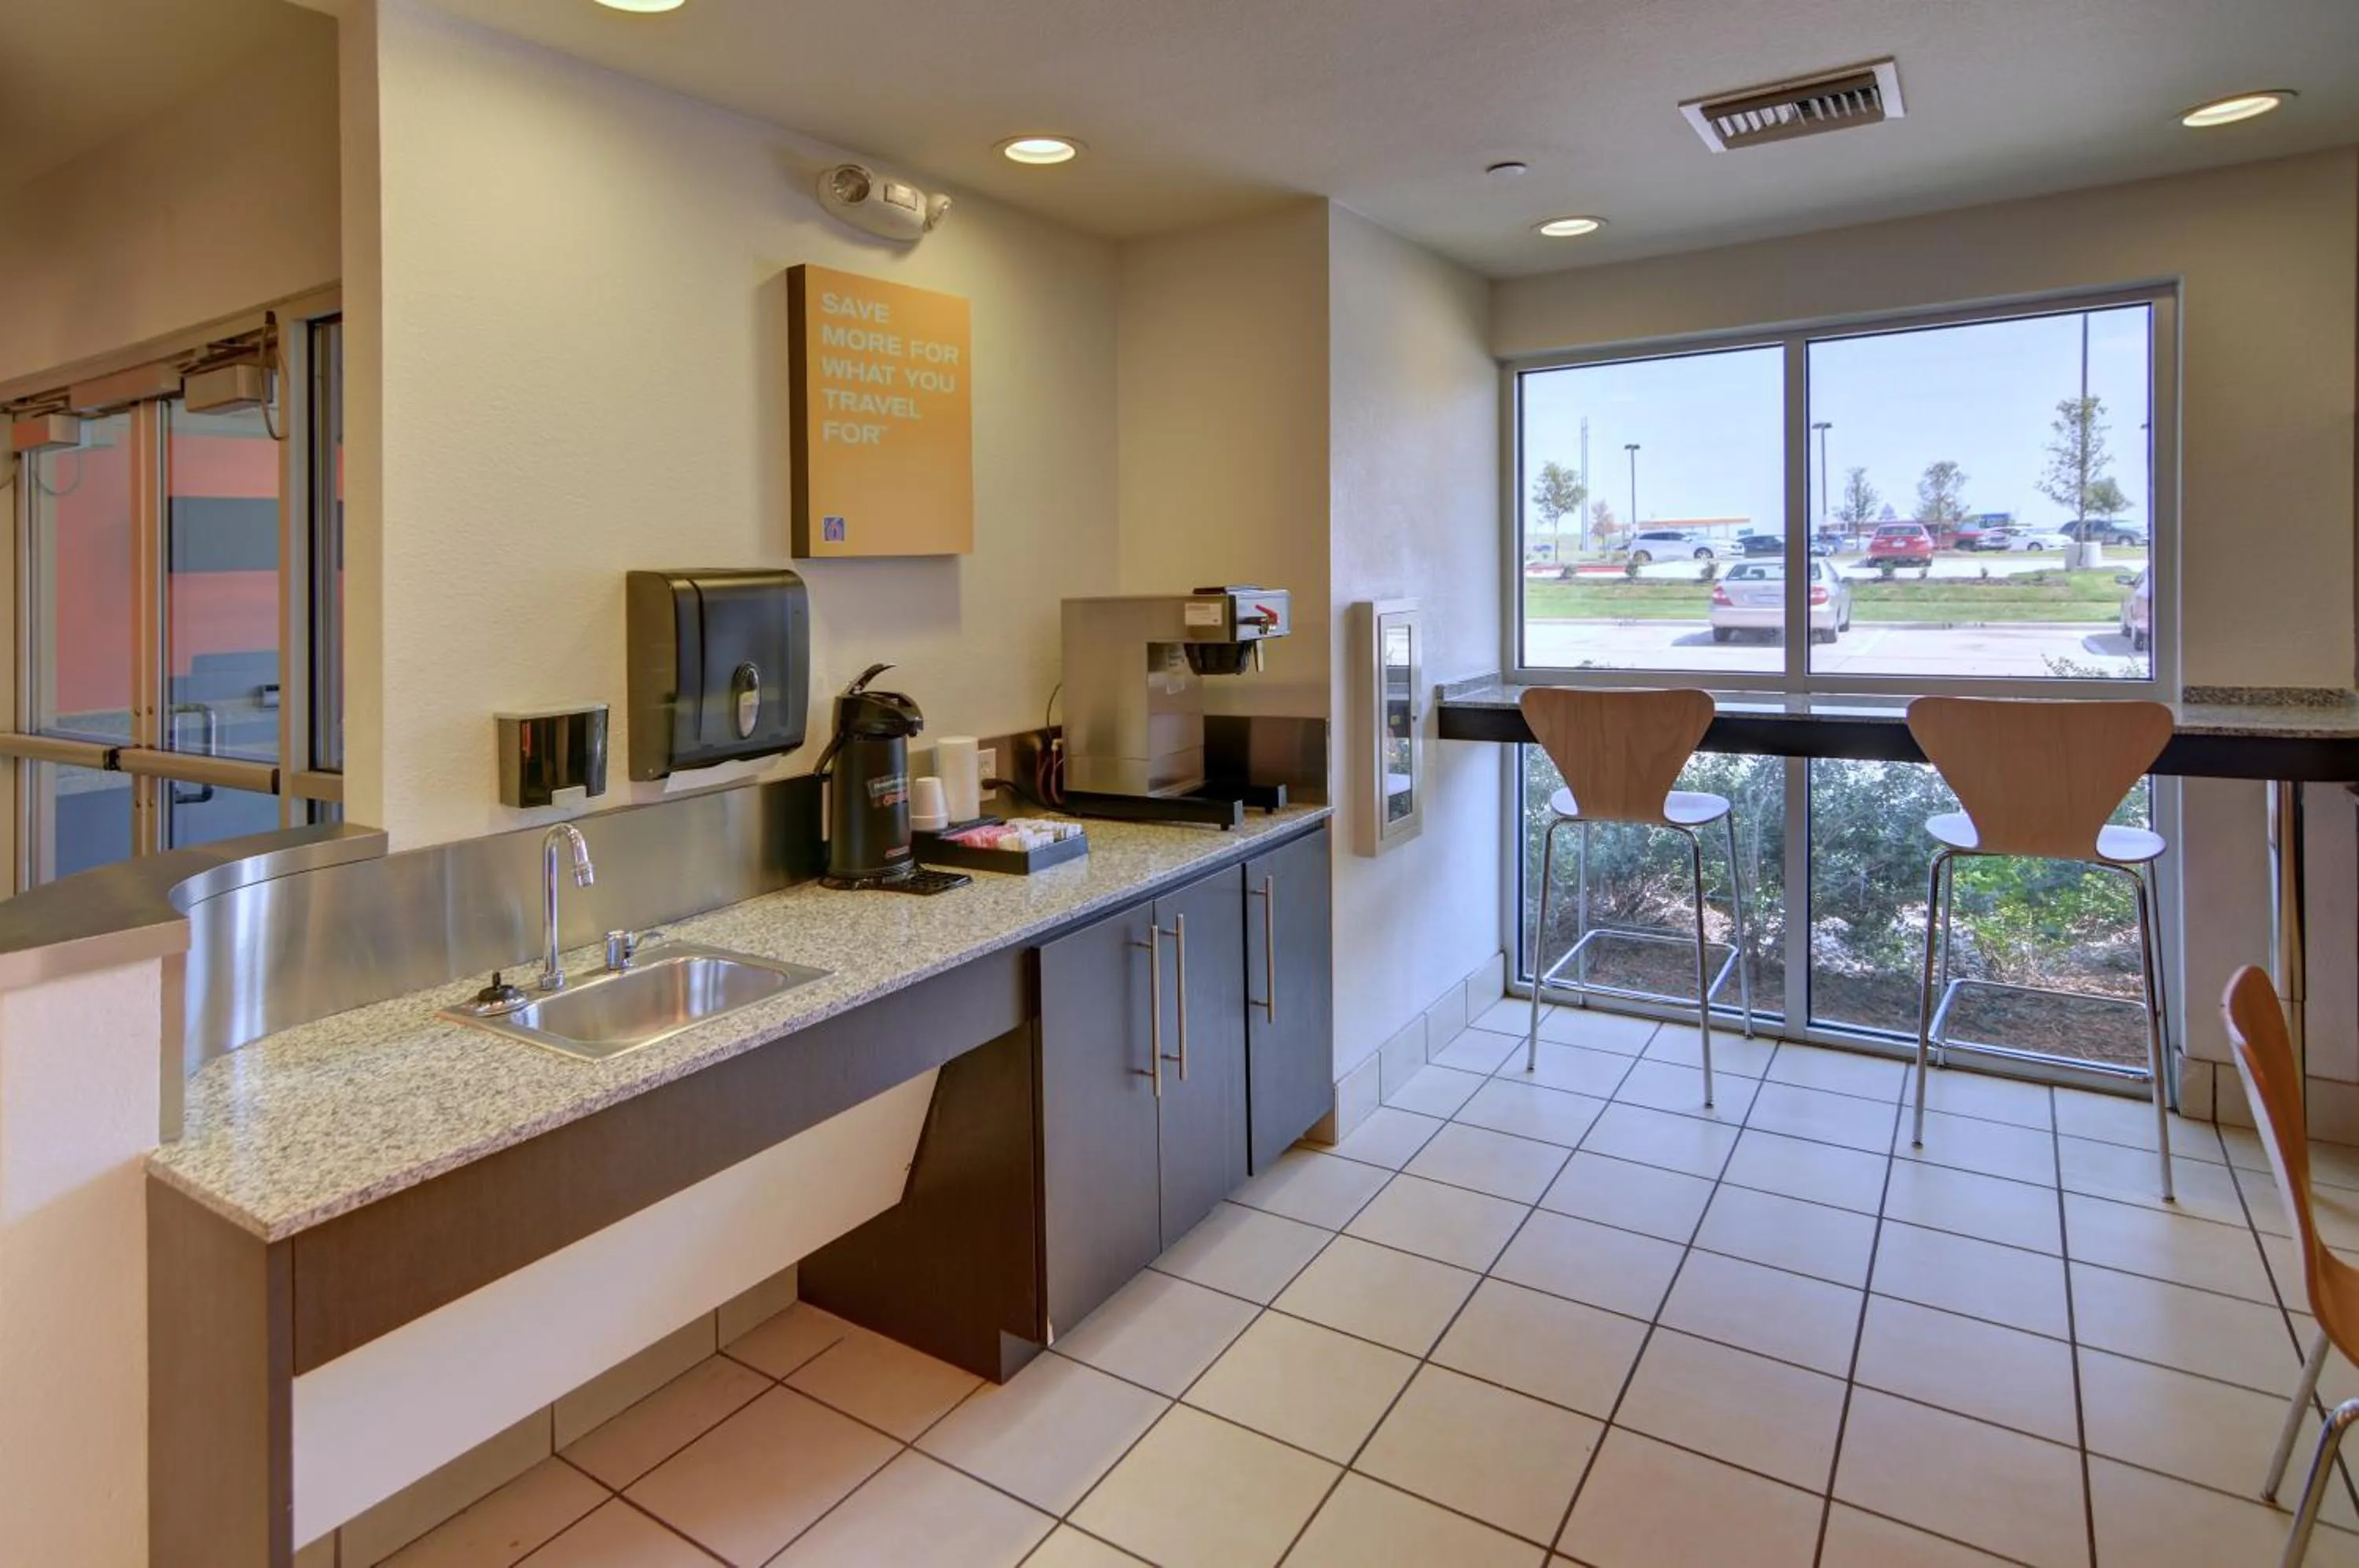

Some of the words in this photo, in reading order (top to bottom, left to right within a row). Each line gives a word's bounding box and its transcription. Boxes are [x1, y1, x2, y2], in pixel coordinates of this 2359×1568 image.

[821, 293, 890, 324] SAVE
[822, 323, 903, 356] MORE
[910, 340, 959, 366] FOR
[822, 356, 895, 386] WHAT
[904, 367, 955, 394] YOU
[822, 388, 922, 421] TRAVEL
